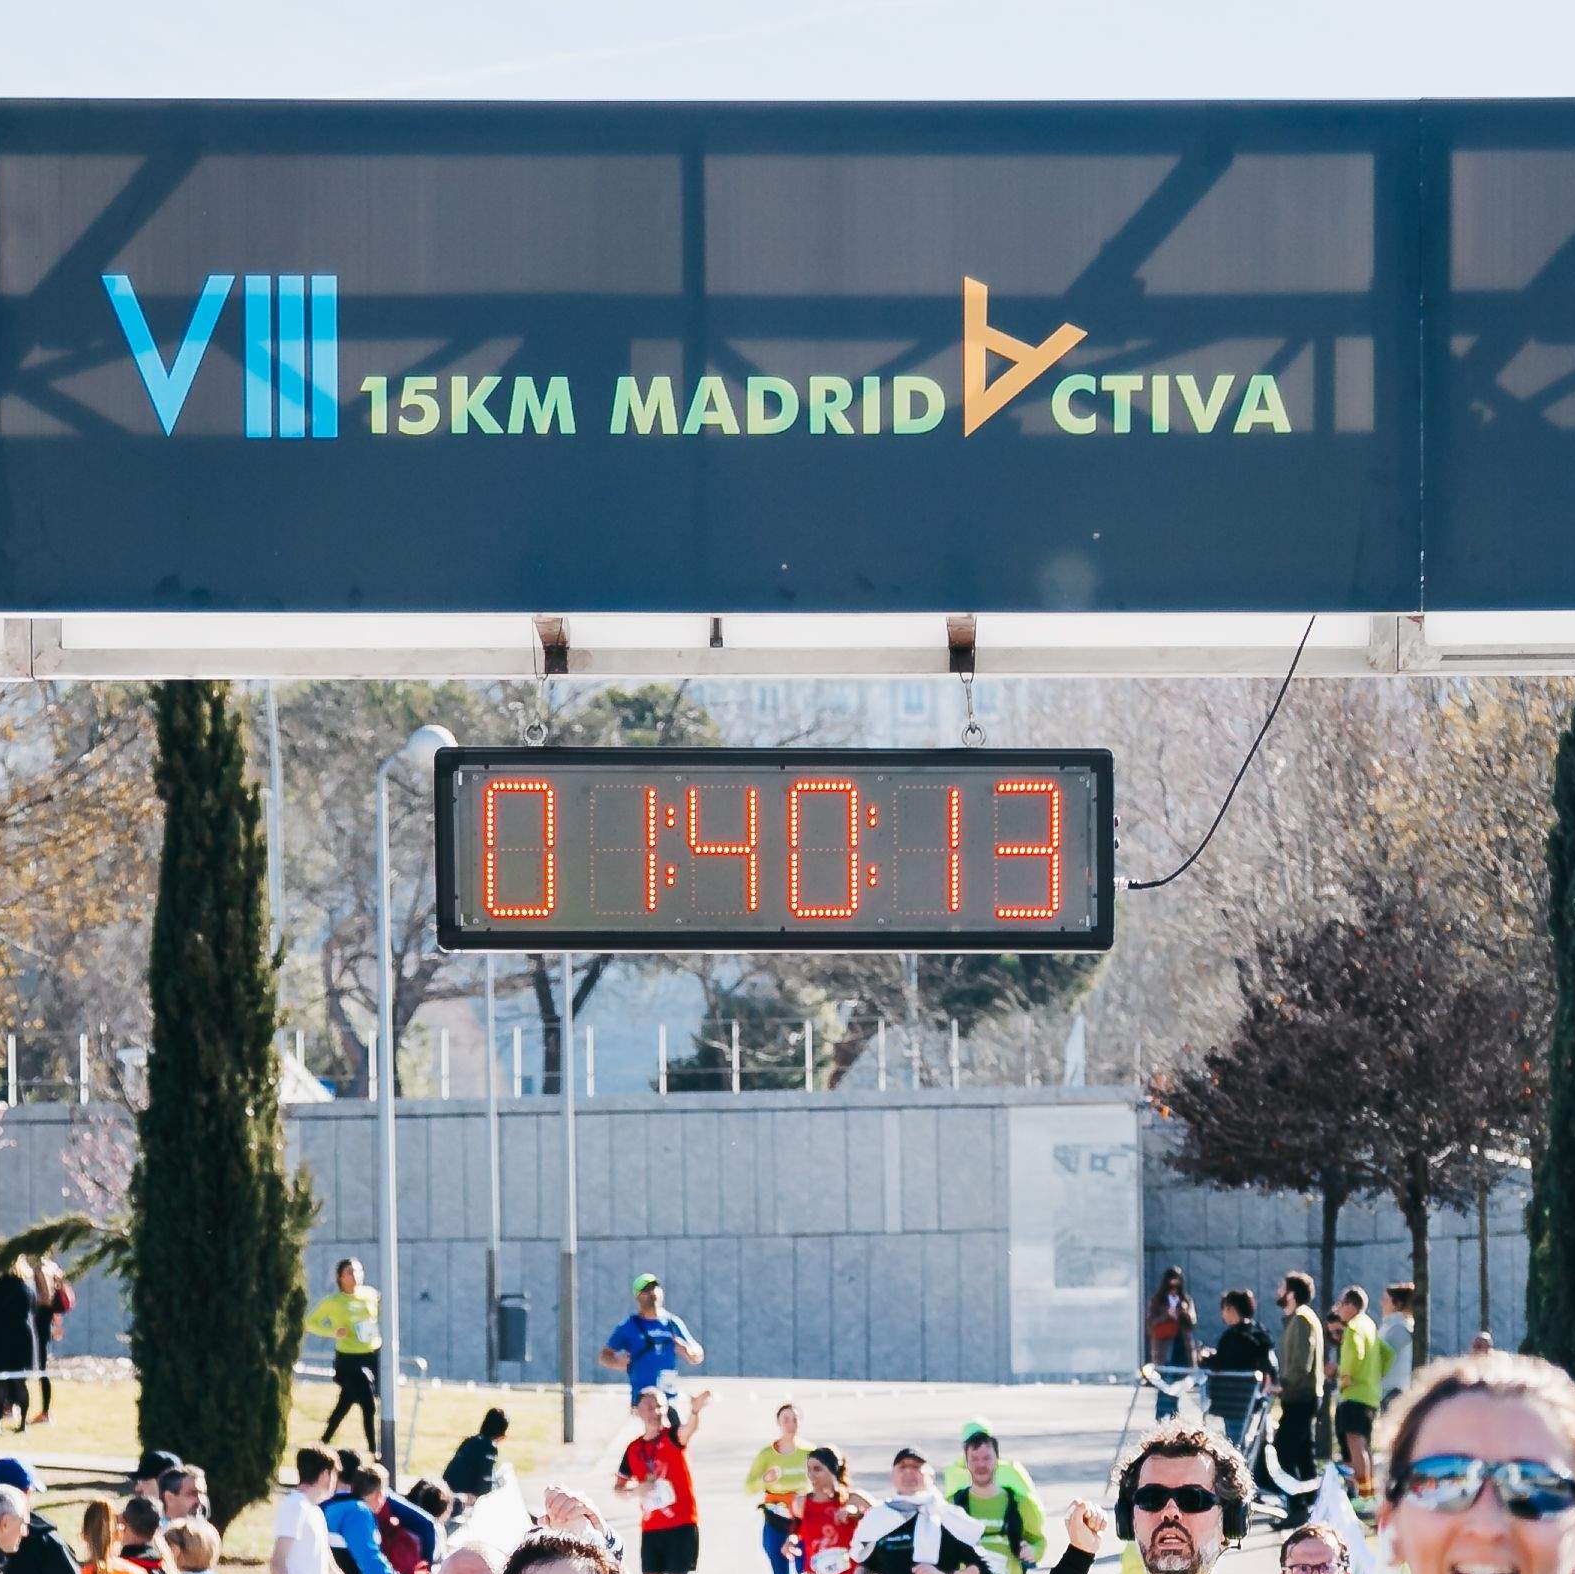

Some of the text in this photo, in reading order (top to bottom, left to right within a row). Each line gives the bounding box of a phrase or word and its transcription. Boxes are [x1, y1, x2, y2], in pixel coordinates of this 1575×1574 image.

[102, 274, 339, 439] VIII
[361, 375, 576, 437] 15KM
[609, 375, 945, 437] MADRID
[483, 779, 1061, 919] 01:40:13
